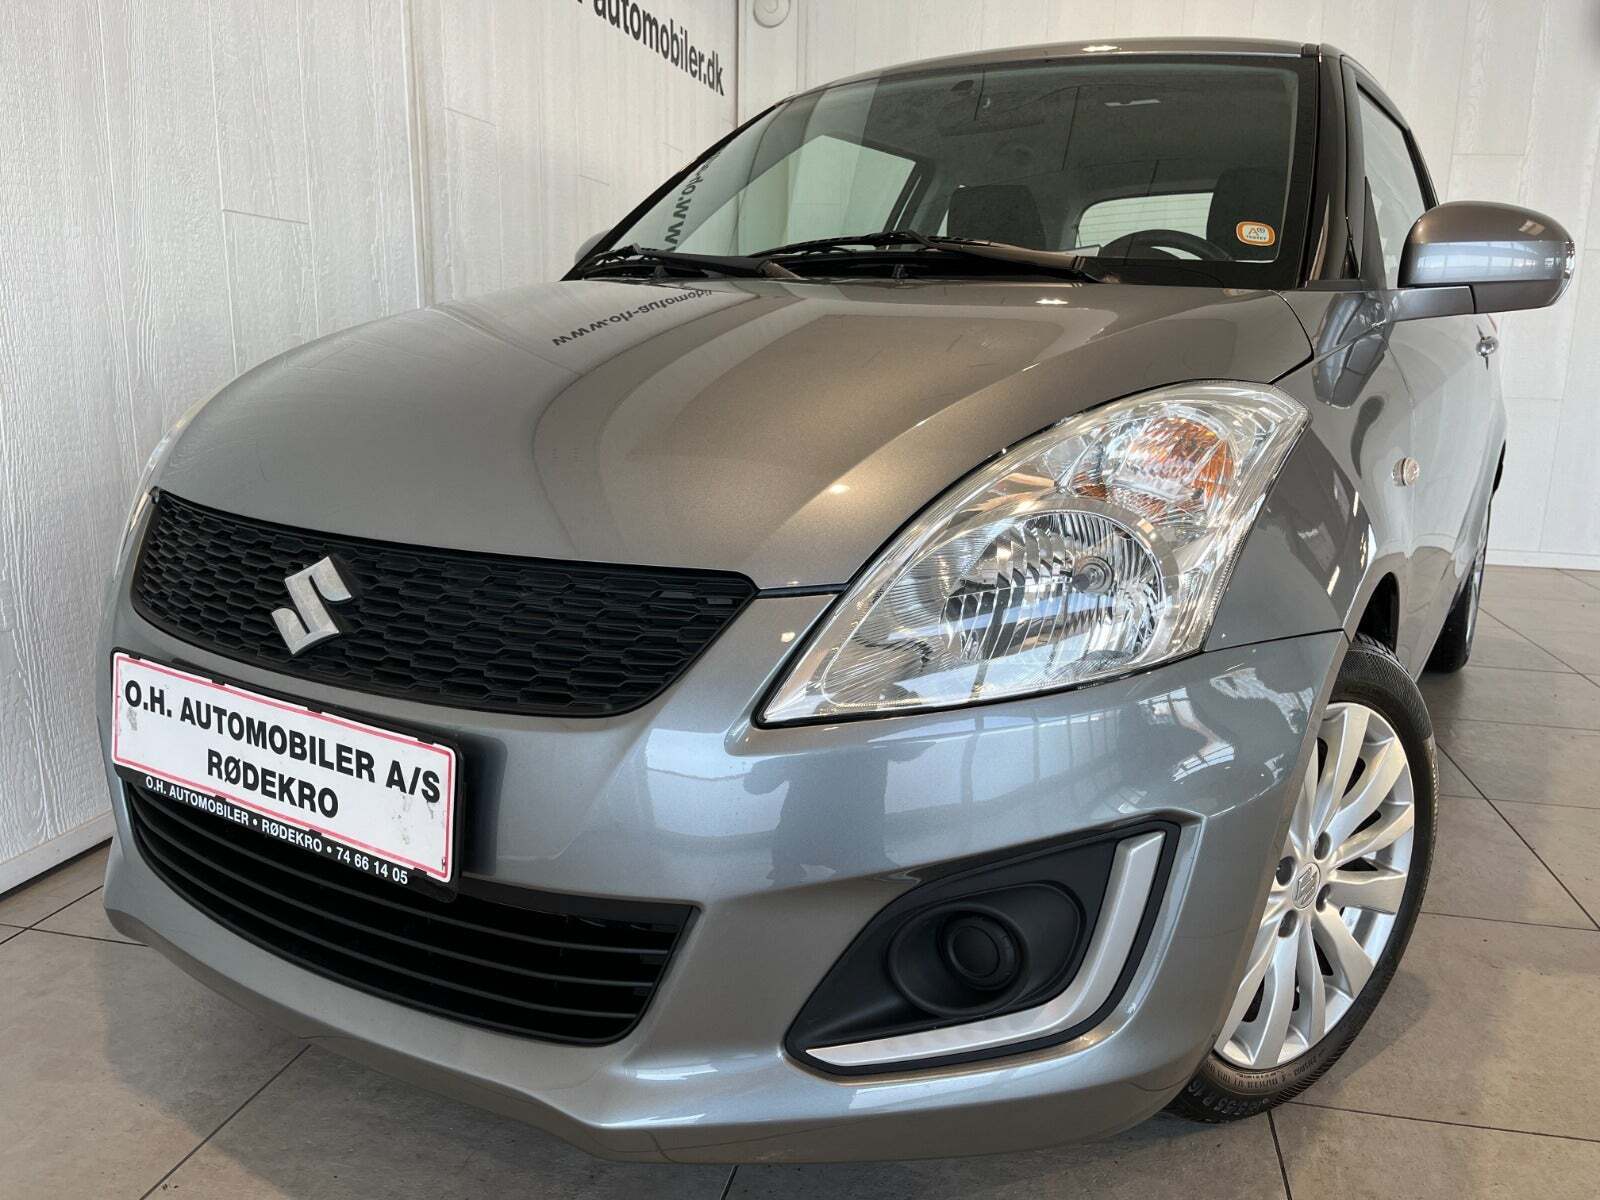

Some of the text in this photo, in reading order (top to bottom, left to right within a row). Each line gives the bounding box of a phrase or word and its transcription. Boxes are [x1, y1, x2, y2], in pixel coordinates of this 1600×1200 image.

[577, 0, 724, 96] automobiler.dk
[125, 679, 441, 804] O.H. AUTOMOBILER A/S
[207, 748, 339, 819] RØDEKRO
[145, 775, 409, 885] O.H. AUTOMOBILER RØDEKRO 74 66 14 05
